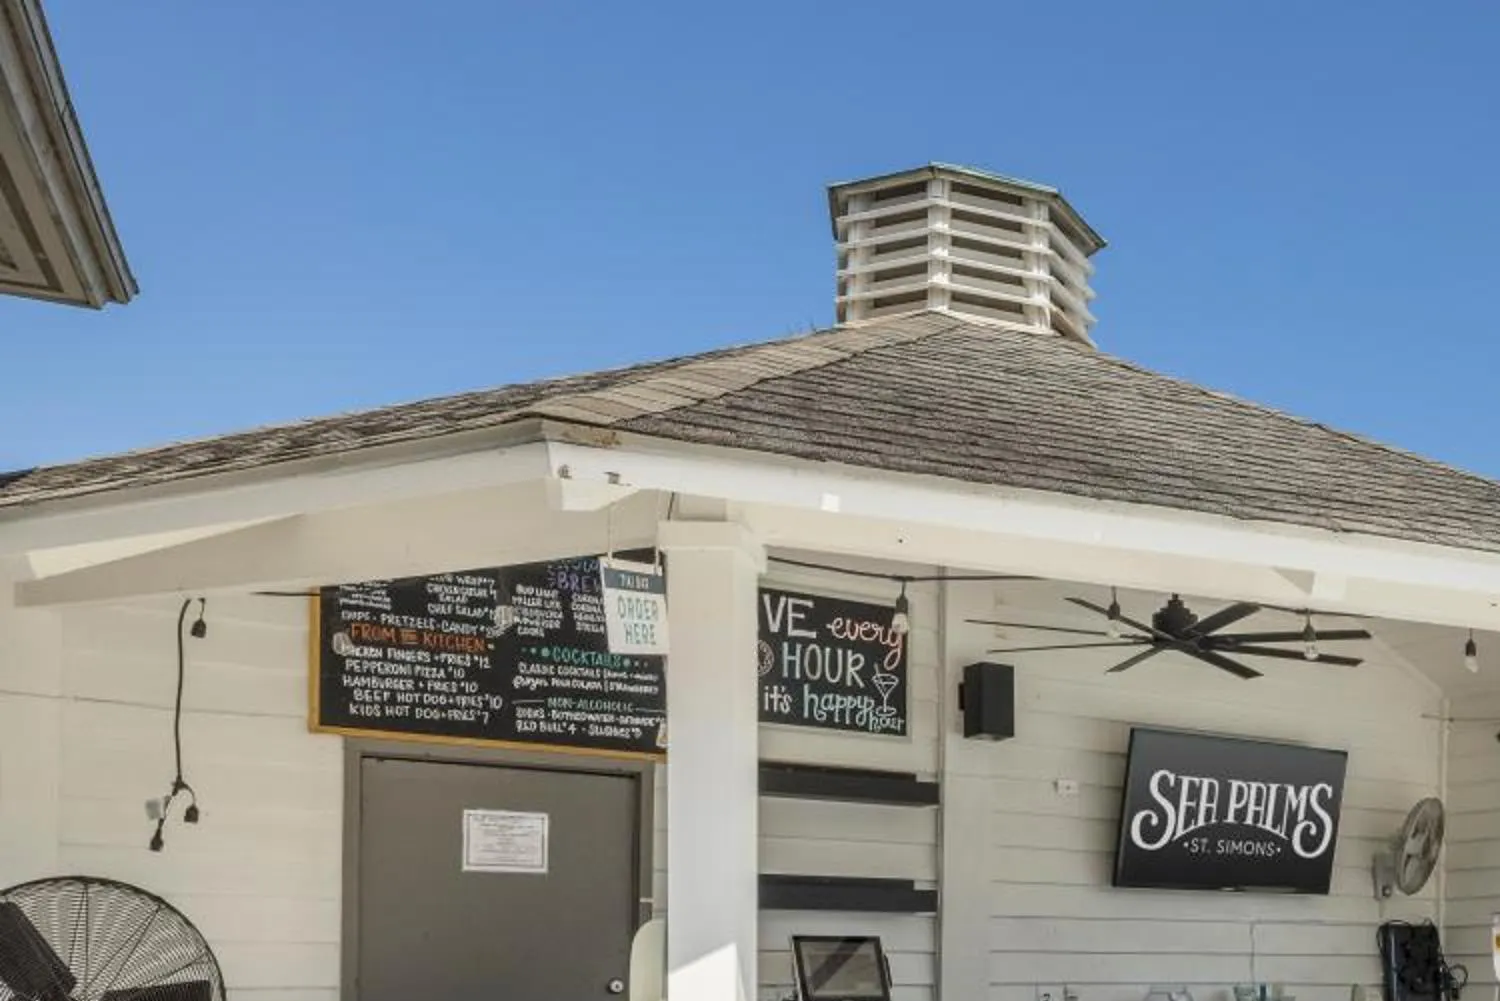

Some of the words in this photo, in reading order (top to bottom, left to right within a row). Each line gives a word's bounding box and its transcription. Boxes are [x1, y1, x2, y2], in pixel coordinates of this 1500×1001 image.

[351, 623, 397, 643] FROM
[423, 631, 486, 653] KITCHEN
[624, 623, 657, 645] HERE
[826, 617, 904, 671] every
[345, 659, 413, 676] PEPPERONI
[553, 647, 622, 669] COCKTAILS
[782, 641, 865, 688] HOUR
[342, 675, 415, 690] HAMBURGER
[353, 688, 392, 702] BEEF
[396, 692, 422, 704] HOT
[423, 693, 447, 705] DOG
[547, 697, 634, 714] NON-ALCOHOLIC
[764, 685, 793, 714] it's
[803, 684, 876, 725] happy
[349, 703, 381, 718] KIDS
[385, 706, 411, 718] HOT
[415, 708, 441, 720] DOG
[1131, 769, 1220, 851] SEA
[1222, 779, 1333, 859] PALMS
[1216, 839, 1276, 857] SIMONS
